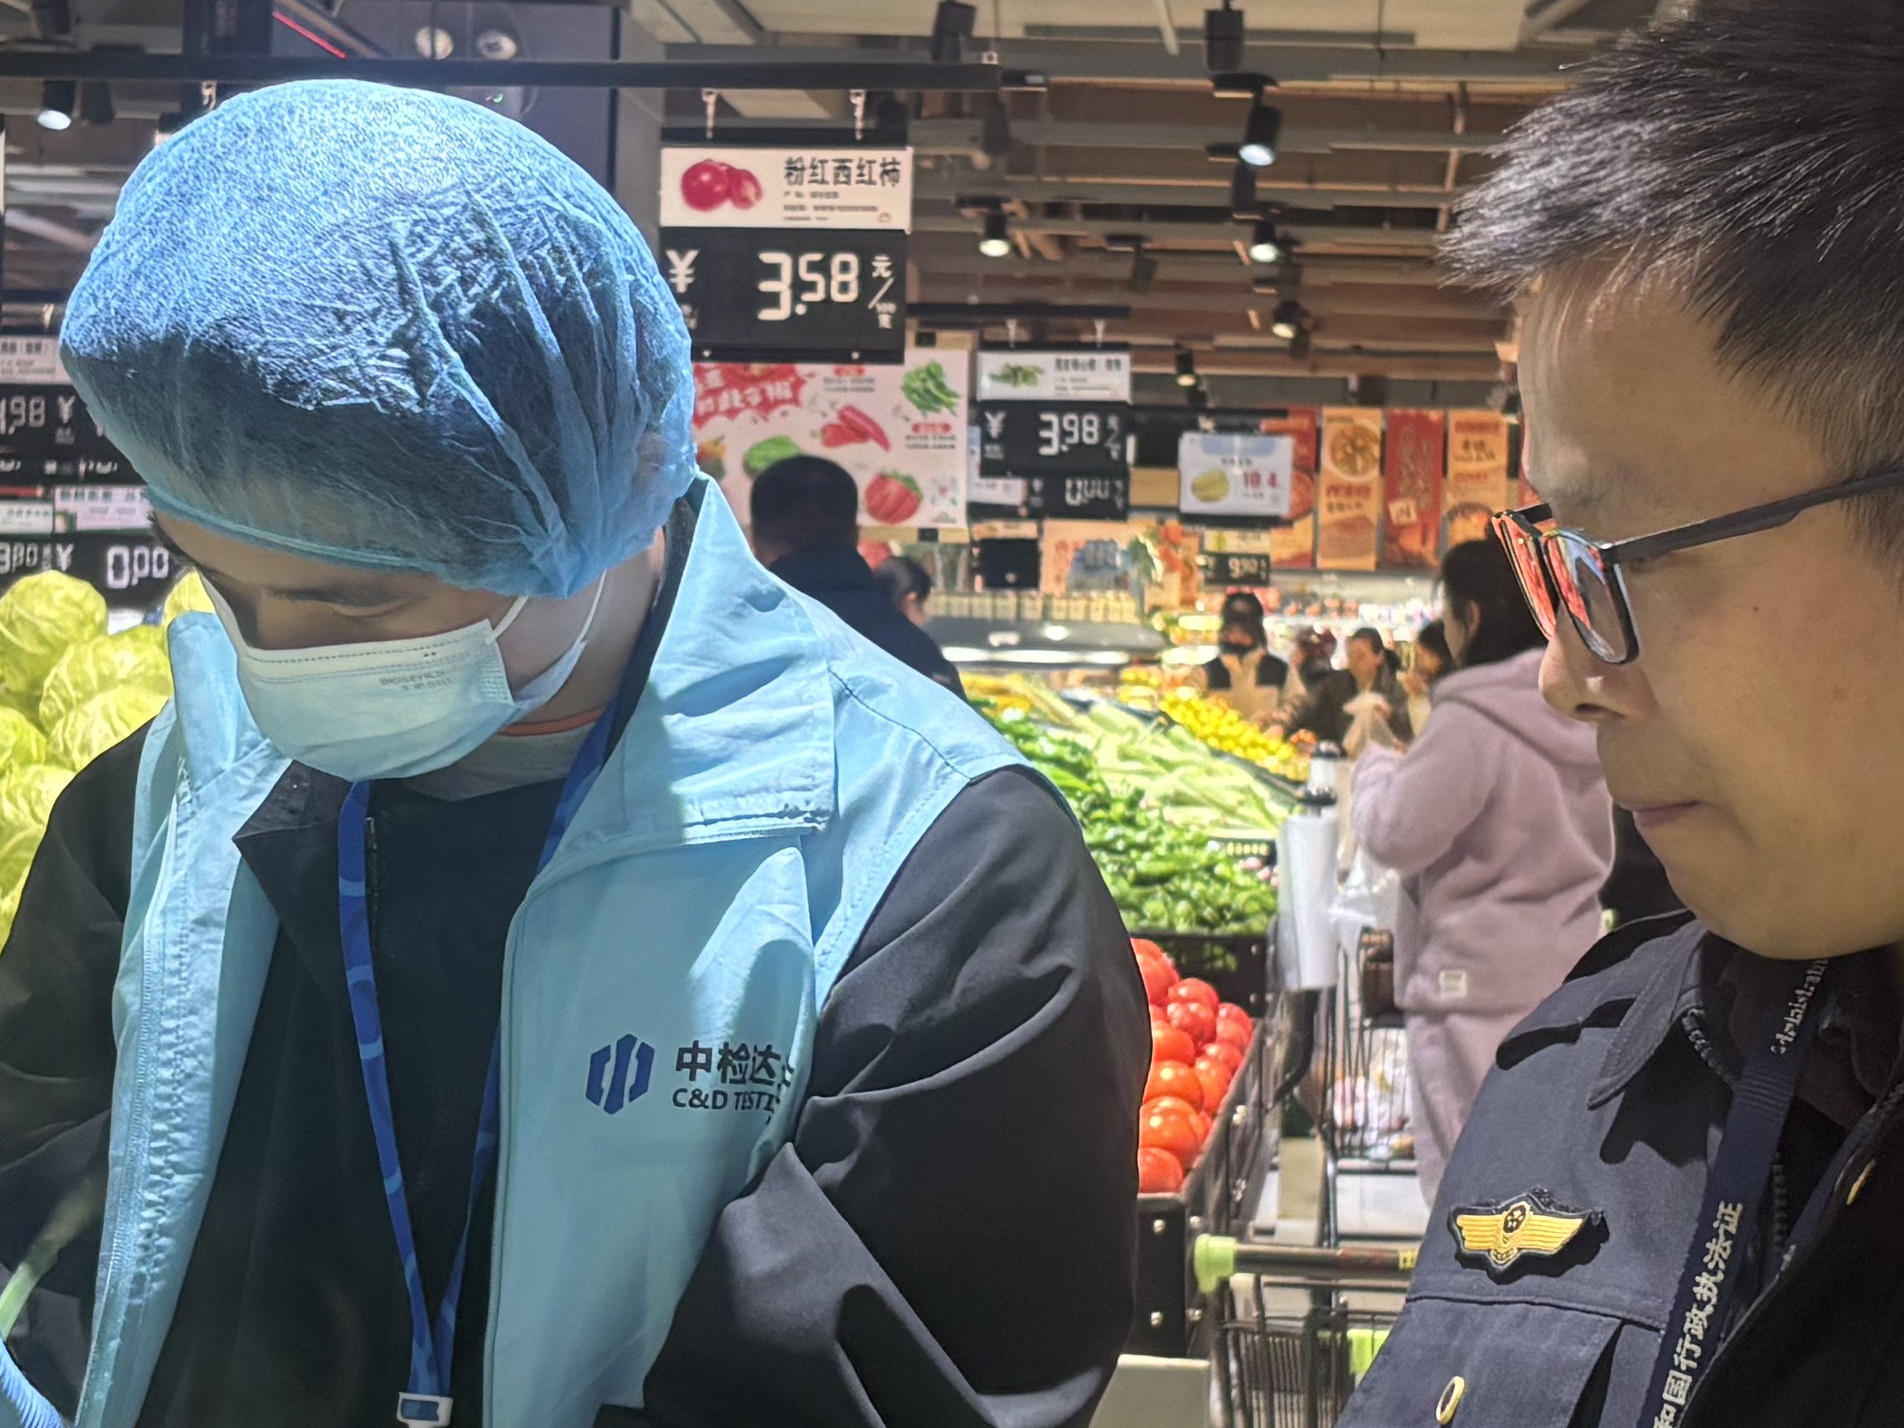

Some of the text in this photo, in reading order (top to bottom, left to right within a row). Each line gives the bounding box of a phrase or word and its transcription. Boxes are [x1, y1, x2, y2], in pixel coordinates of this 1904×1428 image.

[783, 156, 901, 187] 粉红西红柿
[757, 252, 859, 321] 3.58
[1038, 413, 1099, 455] 3.98
[671, 1087, 728, 1111] C&D
